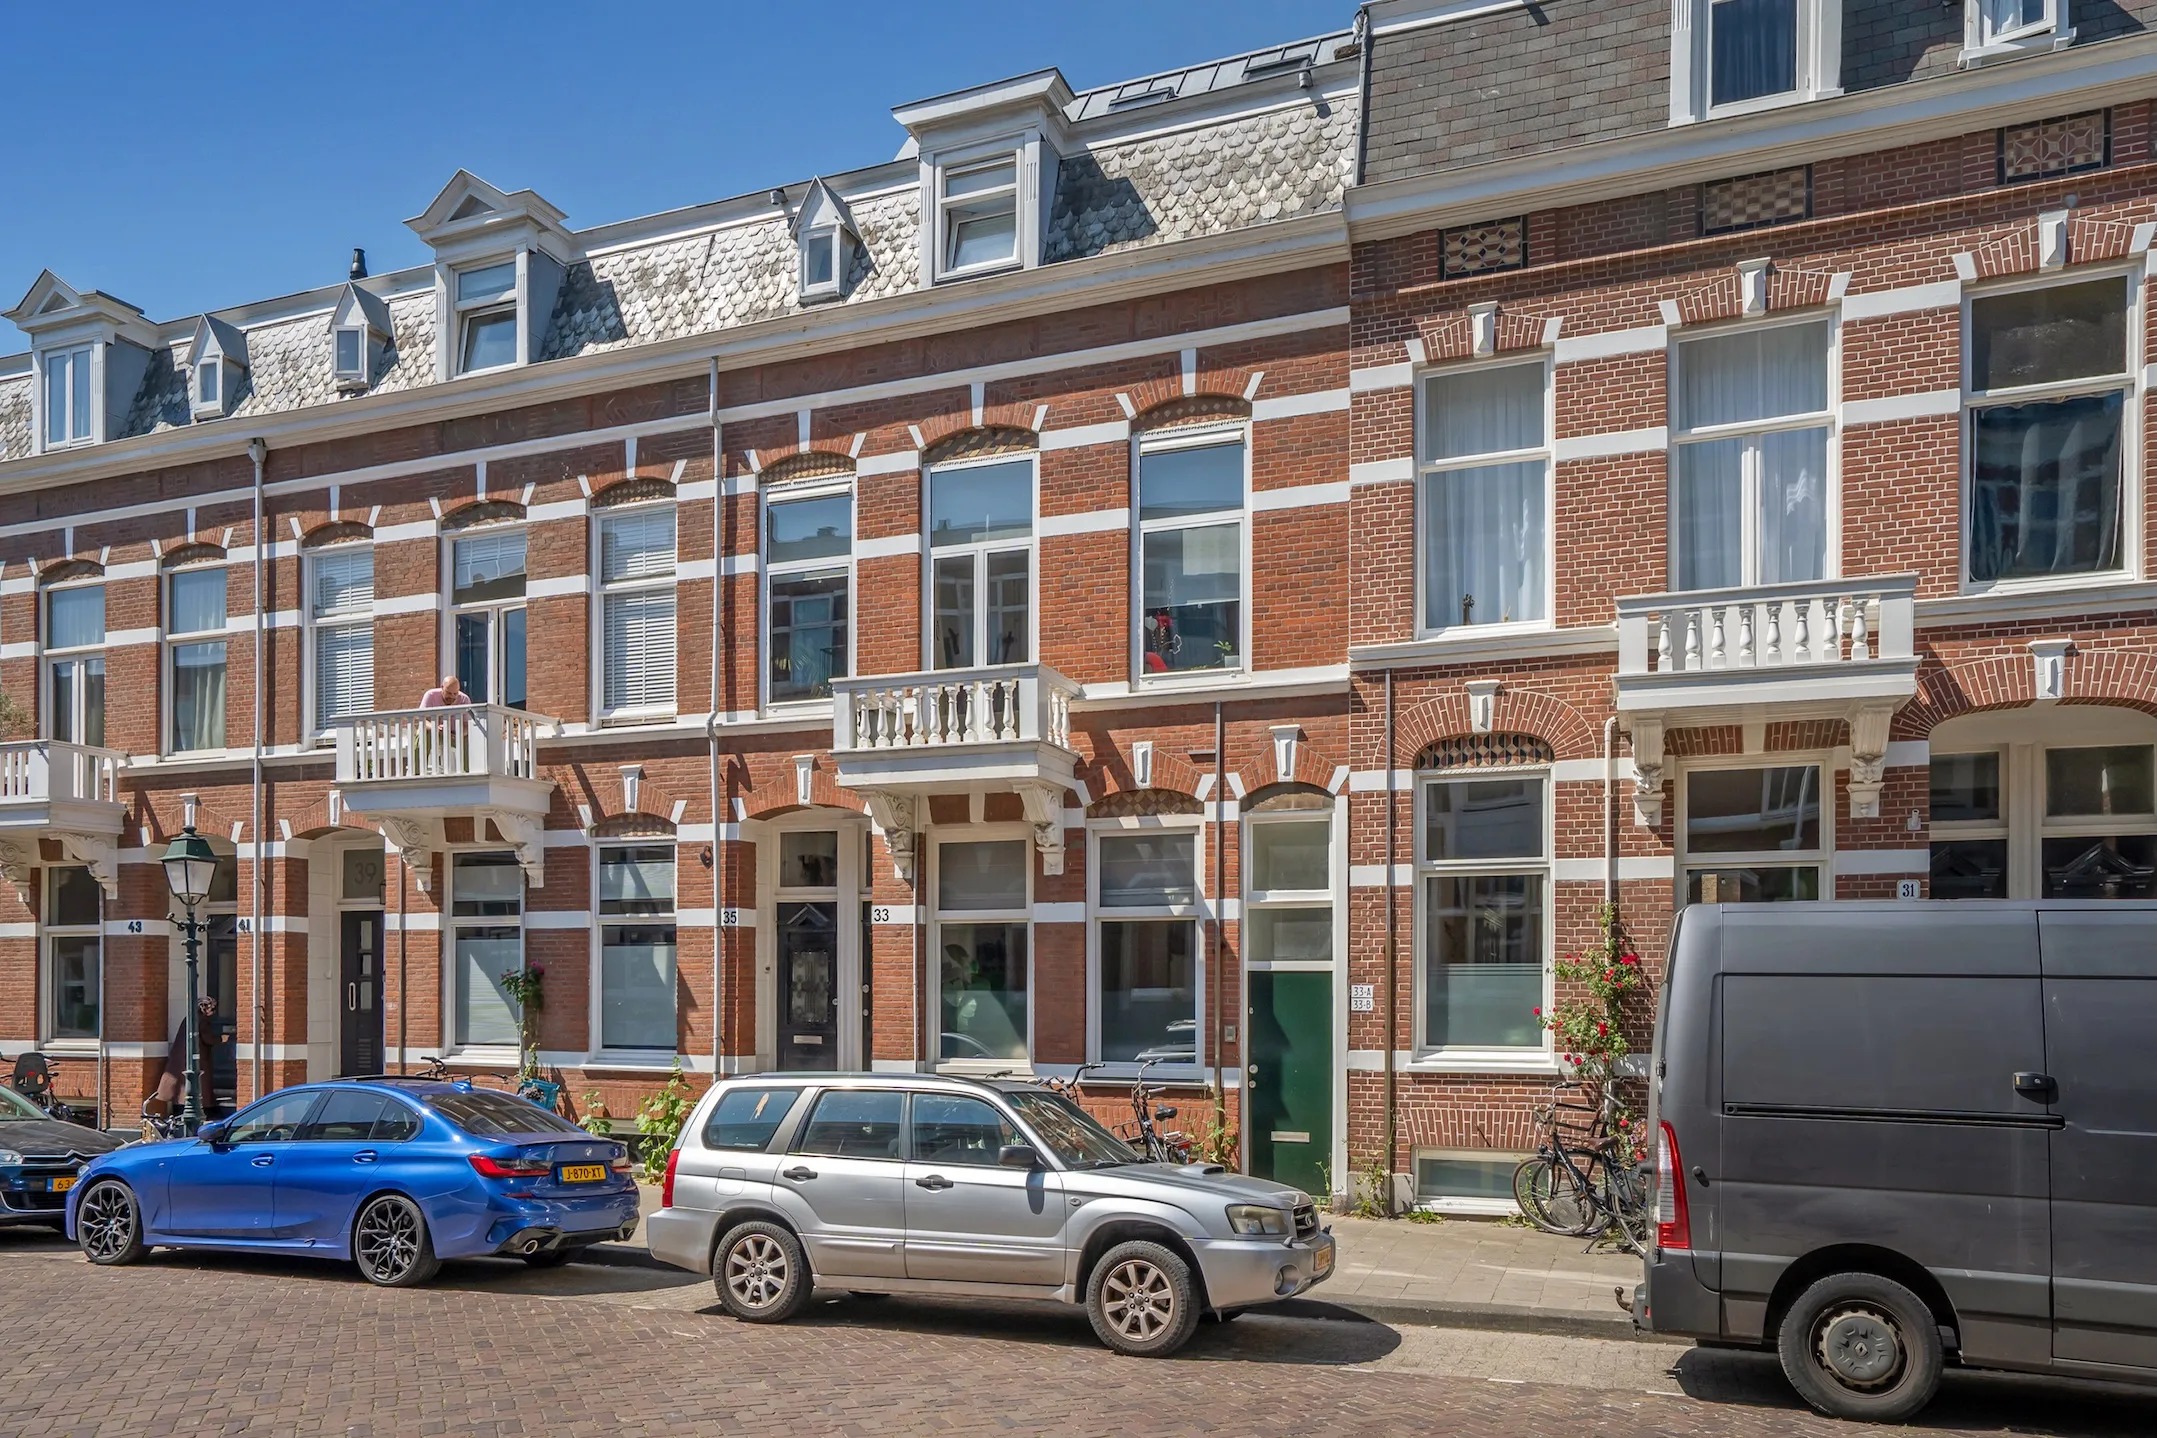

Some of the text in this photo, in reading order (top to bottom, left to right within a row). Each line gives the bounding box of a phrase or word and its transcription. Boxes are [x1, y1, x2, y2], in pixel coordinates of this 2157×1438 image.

[354, 862, 377, 885] 39
[1902, 883, 1915, 897] 31
[723, 910, 737, 924] 35
[873, 908, 889, 922] 33
[128, 920, 143, 933] 43
[238, 918, 251, 934] 41
[566, 1167, 602, 1180] J-870-XT
[57, 1179, 77, 1189] 63-
